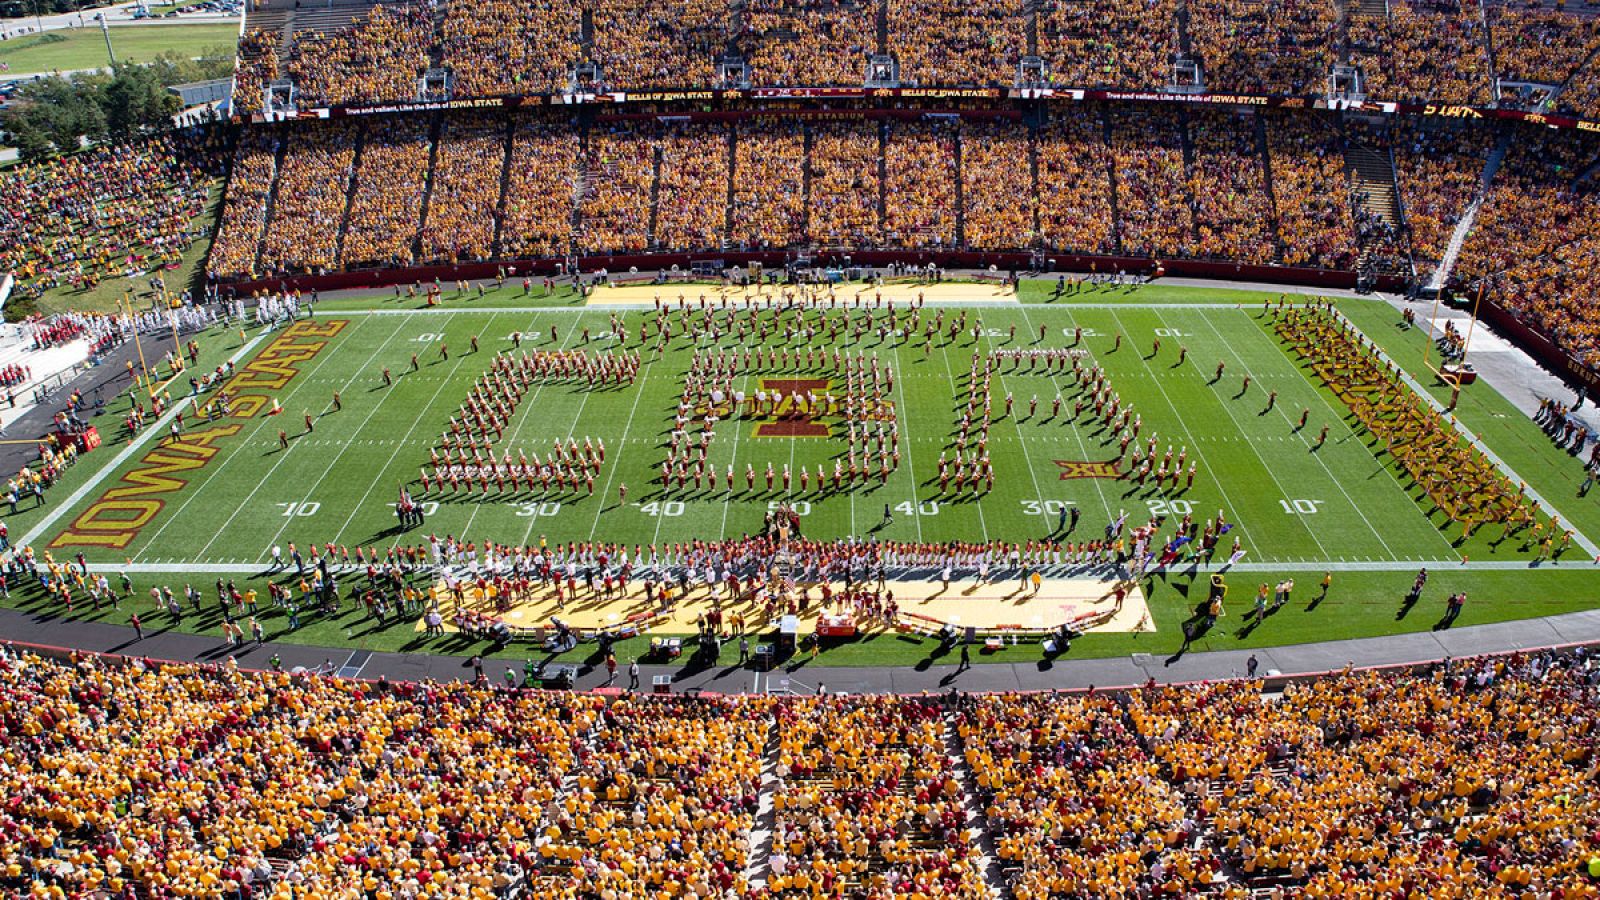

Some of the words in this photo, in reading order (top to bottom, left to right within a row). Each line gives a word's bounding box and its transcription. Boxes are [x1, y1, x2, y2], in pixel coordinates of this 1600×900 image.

[627, 93, 651, 101] BELLS
[664, 92, 686, 100] IOWA
[901, 89, 925, 97] BELLS
[940, 89, 961, 98] IOWA
[962, 89, 989, 97] STATE
[1121, 92, 1135, 100] and
[1203, 95, 1212, 103] of
[1212, 95, 1236, 103] IOWA
[1236, 96, 1268, 105] STATE
[450, 100, 473, 109] IOWA
[474, 98, 503, 108] STATE
[817, 112, 865, 120] STADIUM
[45, 423, 245, 549] IOWA
[193, 318, 351, 420] STATE
[281, 502, 321, 517] 10
[514, 501, 561, 517] 30
[639, 501, 686, 517] 40
[894, 501, 940, 516] 40
[1020, 501, 1064, 516] 30
[1146, 500, 1194, 515] 20
[1280, 500, 1318, 514] 10
